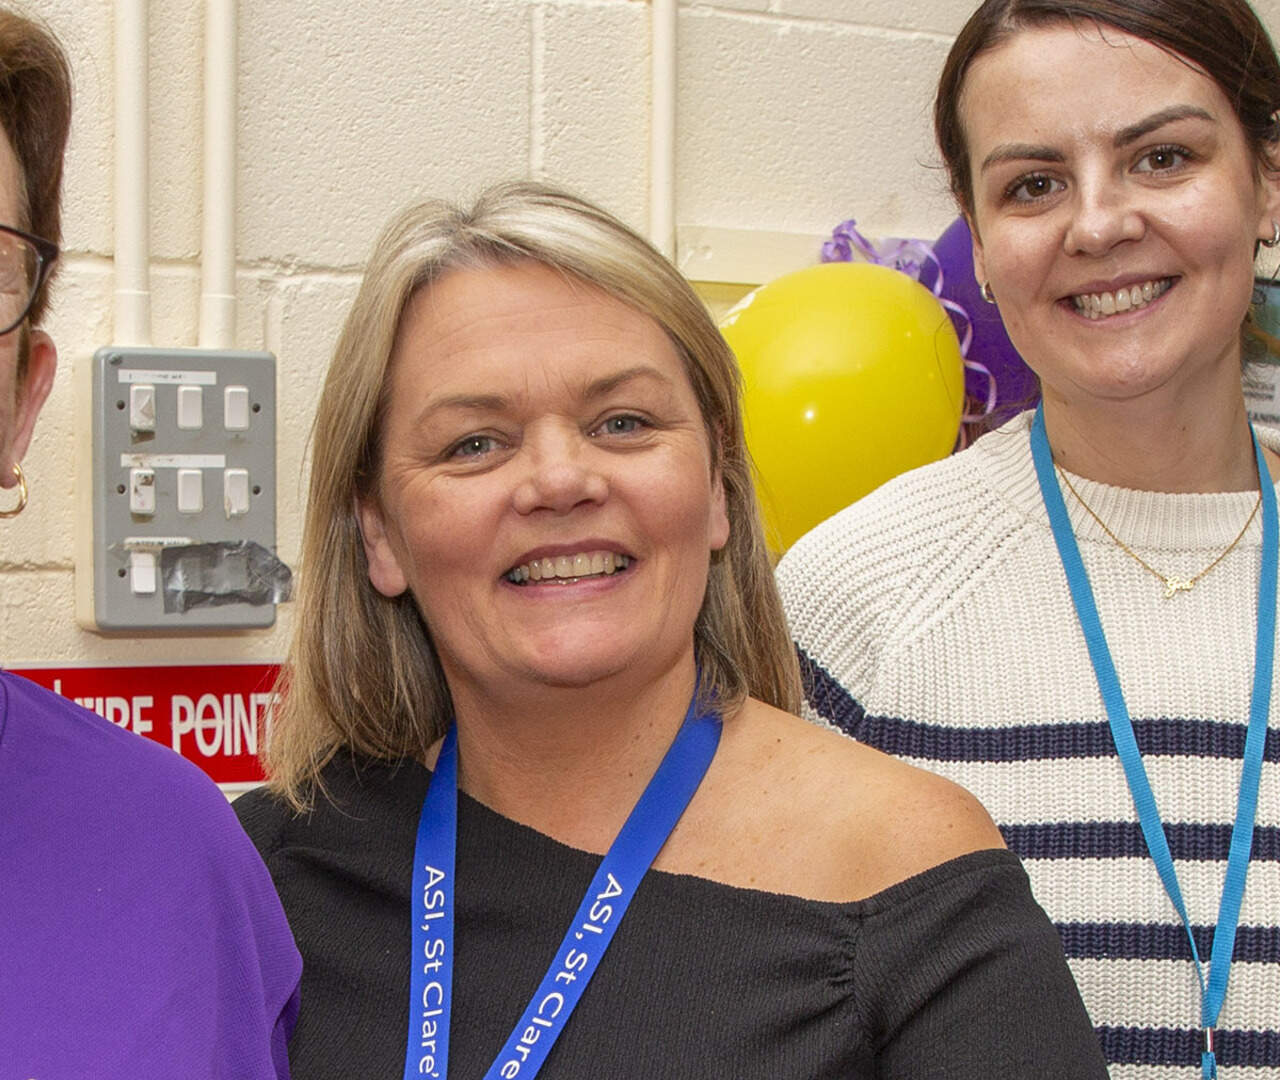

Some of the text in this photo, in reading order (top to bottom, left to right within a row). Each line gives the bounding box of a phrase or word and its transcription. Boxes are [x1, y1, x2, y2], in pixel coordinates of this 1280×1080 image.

[74, 692, 281, 758] RE POINT
[421, 865, 446, 932] ASI,
[574, 872, 623, 940] ASI,
[423, 938, 445, 974] St
[555, 948, 588, 985] St
